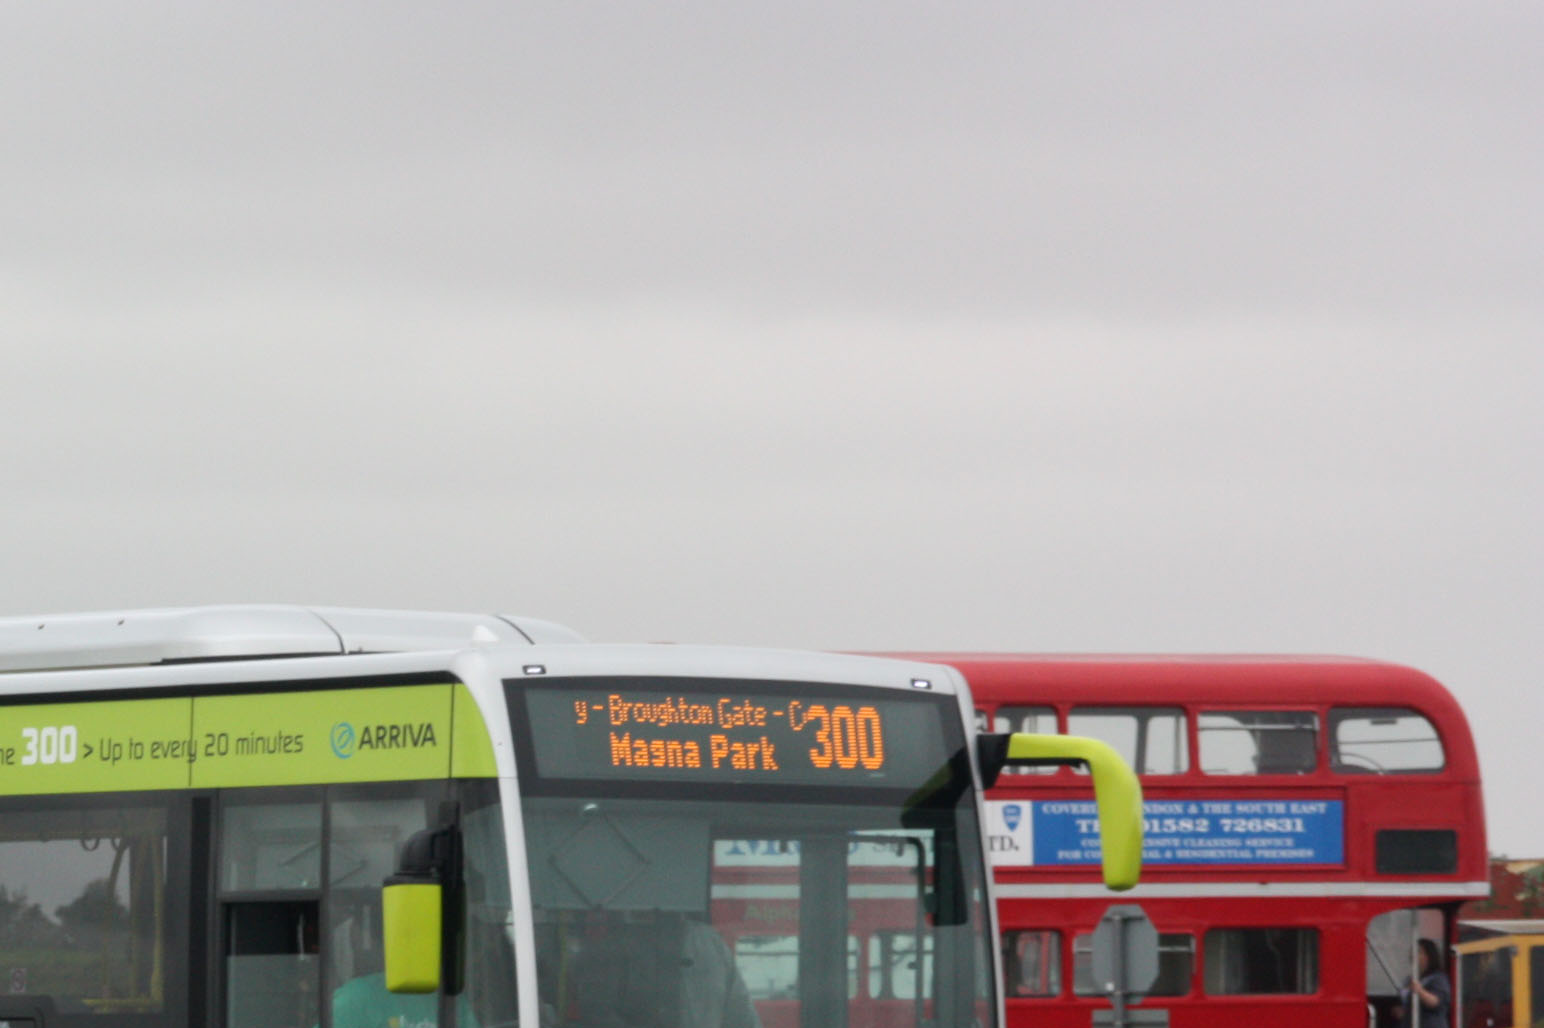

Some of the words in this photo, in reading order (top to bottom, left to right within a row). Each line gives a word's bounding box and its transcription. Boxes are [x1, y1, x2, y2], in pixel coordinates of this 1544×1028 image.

[609, 694, 714, 727] Broughton
[717, 698, 767, 729] Gate
[21, 725, 78, 766] 300
[99, 738, 123, 767] Up
[128, 738, 145, 760] to
[150, 738, 198, 764] every
[204, 733, 229, 757] 20
[235, 731, 304, 756] minutes
[358, 723, 437, 750] ARRIVA
[609, 731, 701, 768] Magna
[710, 733, 779, 770] Park
[806, 704, 884, 769] 300
[1202, 803, 1232, 815] THE
[1236, 803, 1286, 815] SOUTH
[1290, 802, 1328, 815] EAST
[1219, 817, 1306, 833] 726831
[987, 835, 1020, 852] TD.
